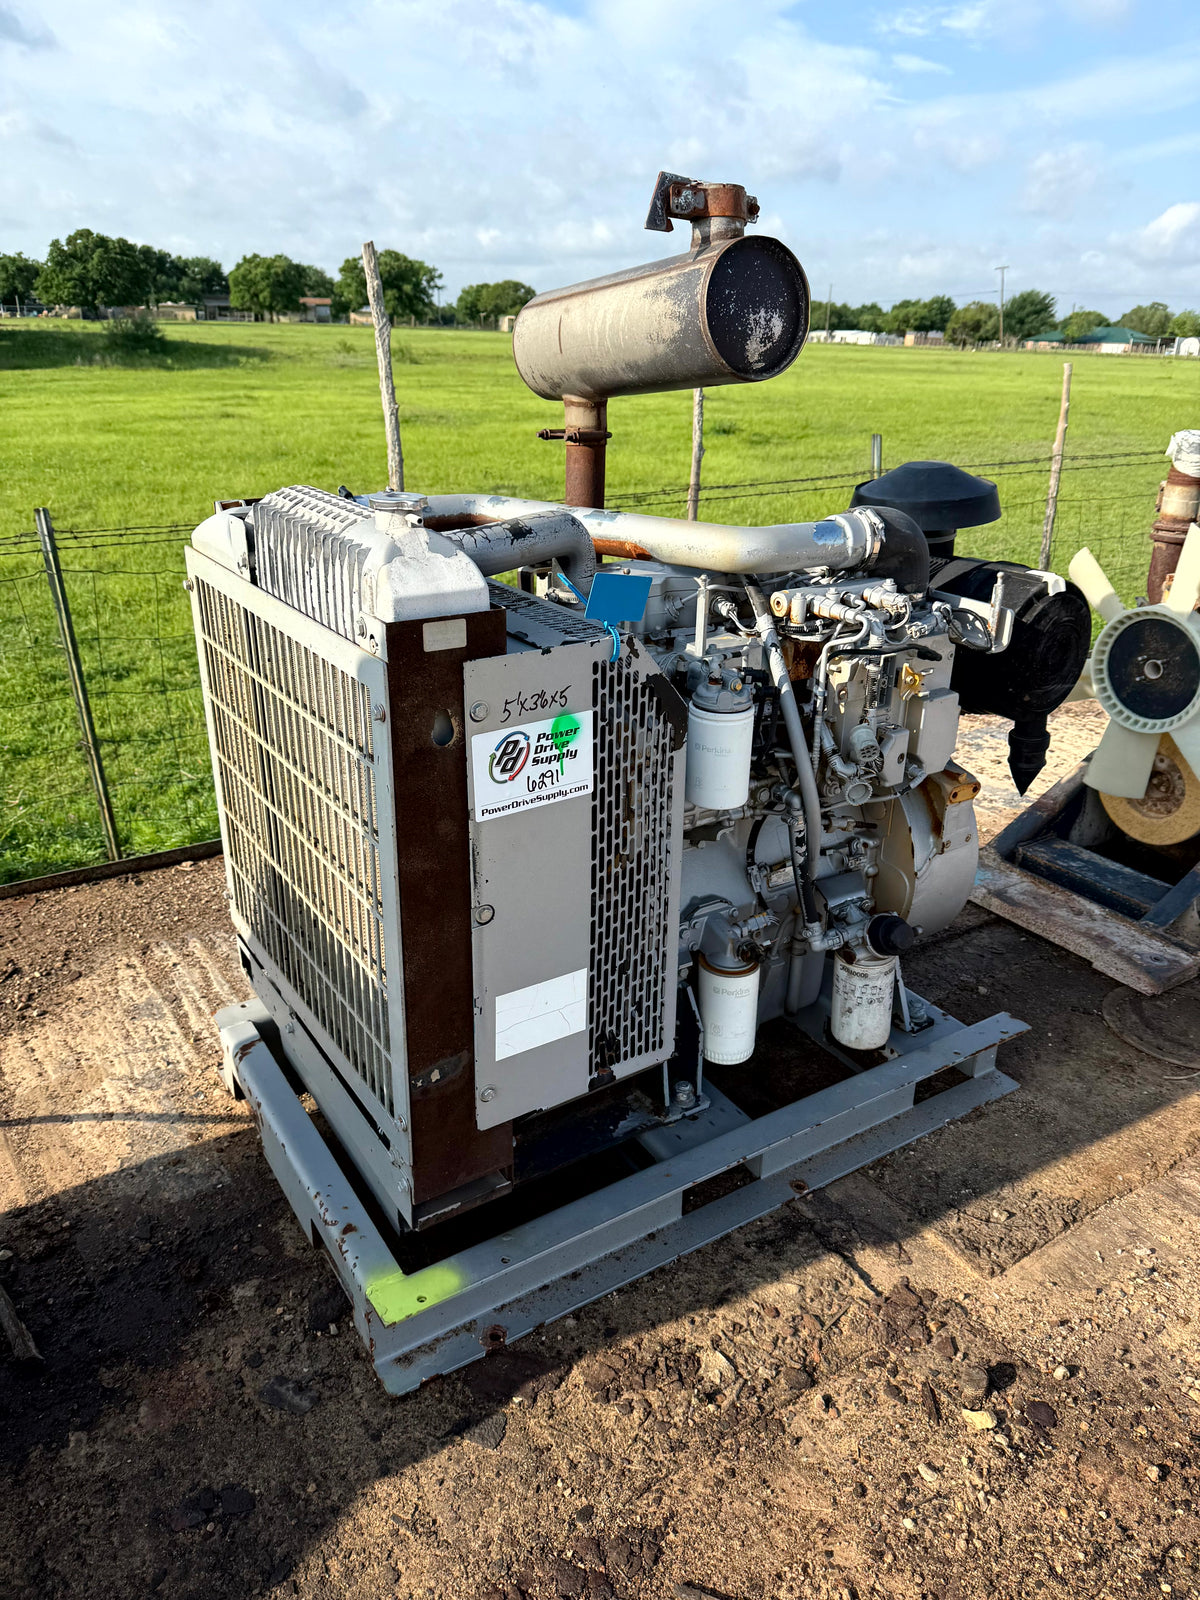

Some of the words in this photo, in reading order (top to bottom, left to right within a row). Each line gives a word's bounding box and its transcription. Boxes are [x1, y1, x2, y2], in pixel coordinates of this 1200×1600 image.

[537, 727, 580, 743] Power
[534, 740, 570, 755] Drive
[532, 749, 578, 766] Supply
[526, 769, 560, 793] 6291
[481, 784, 589, 817] PowerDriveSupply.com
